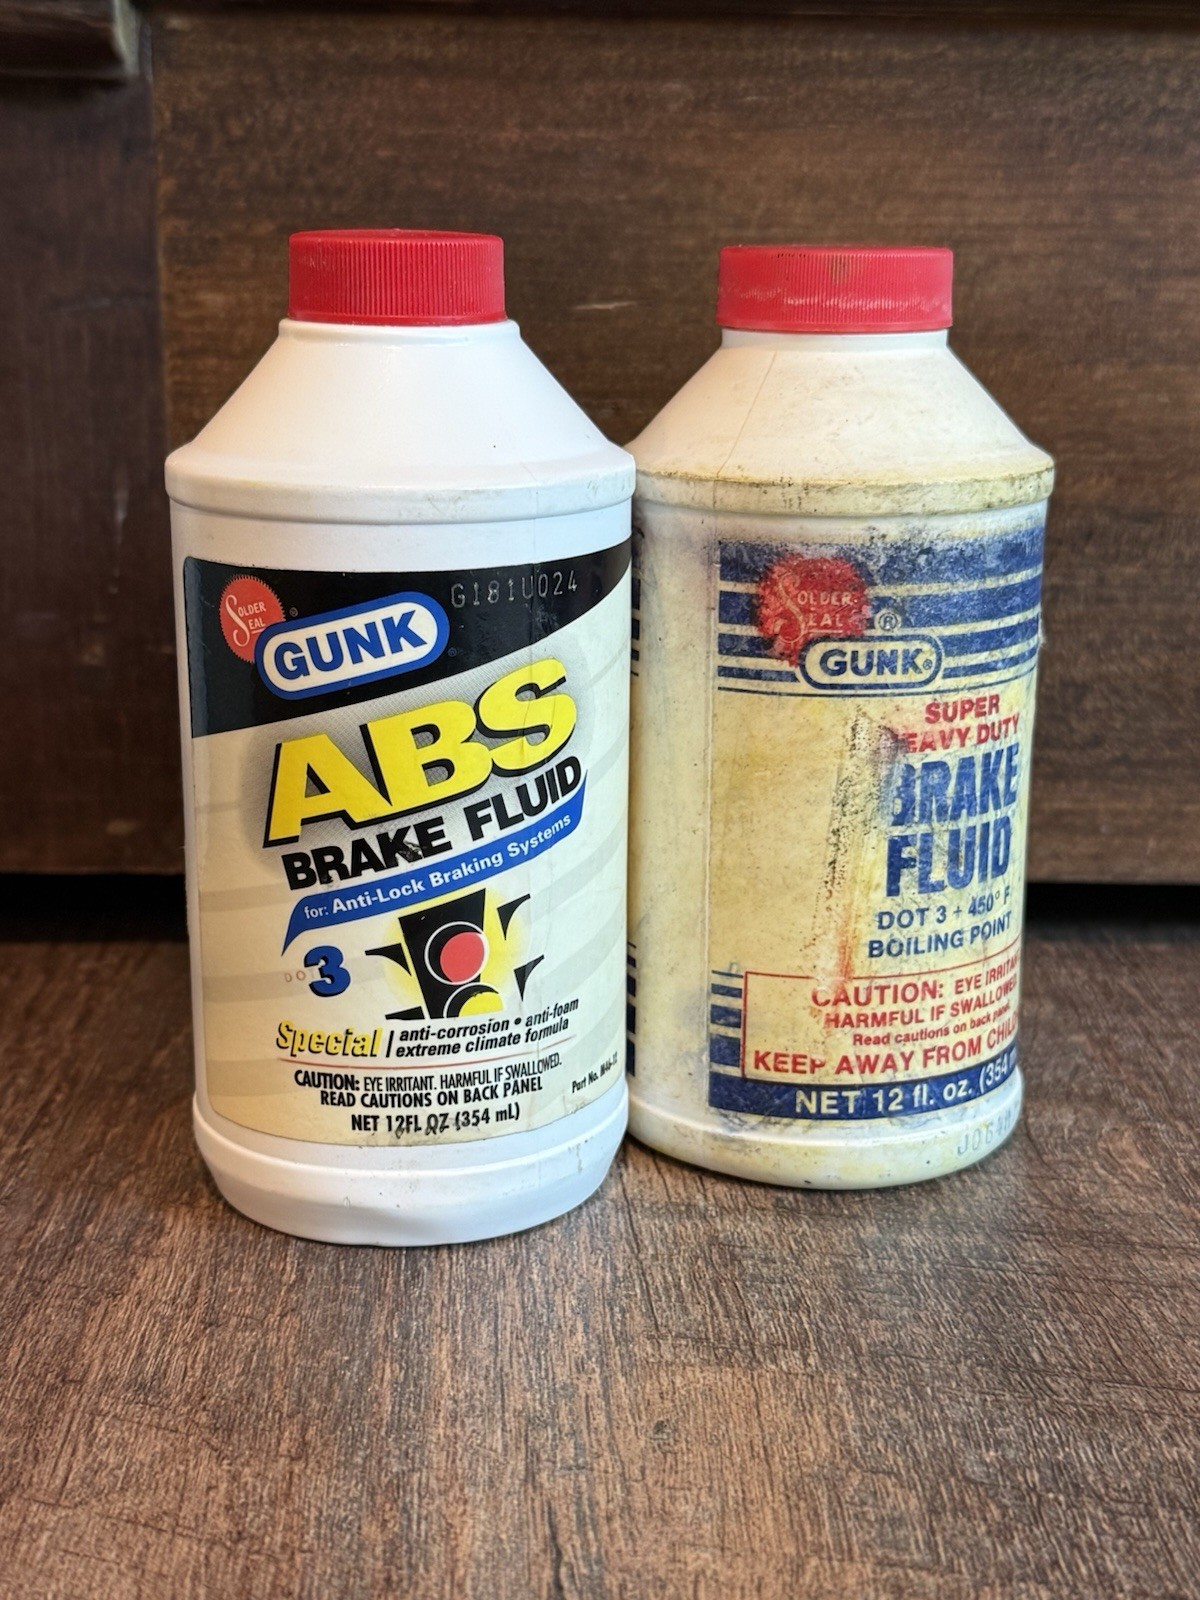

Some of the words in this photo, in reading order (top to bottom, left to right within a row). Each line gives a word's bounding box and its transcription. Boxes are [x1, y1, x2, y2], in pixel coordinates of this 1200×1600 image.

[274, 609, 428, 681] GUNK
[819, 648, 924, 677] GUNK
[925, 693, 1000, 724] SUPER
[263, 658, 578, 847] ABS
[901, 727, 970, 754] EAVY
[977, 712, 1020, 745] DUTY
[889, 742, 1019, 827] BRAKE
[281, 816, 453, 891] BRAKE
[463, 755, 582, 841] FLUID
[303, 905, 329, 919] for:
[332, 879, 426, 914] Anti-Lock
[428, 851, 504, 887] Braking
[507, 814, 572, 857] Systems
[886, 816, 1012, 897] FLUID
[877, 908, 929, 930] DOT
[936, 905, 947, 923] 3
[1003, 886, 1011, 905] F
[868, 930, 964, 958] BOILING
[970, 911, 1012, 943] POINT
[304, 945, 351, 997] 3
[811, 979, 943, 1007] CAUTION:
[955, 976, 981, 995] EYE
[399, 1018, 510, 1041] anti-corrosion
[525, 998, 579, 1027] anti-foam
[824, 1008, 923, 1030] HARMFUL
[931, 1005, 944, 1021] IF
[853, 1032, 890, 1047] Read
[895, 1026, 949, 1043] cautions
[953, 1022, 967, 1034] on
[970, 1014, 991, 1029] back
[276, 1019, 383, 1057] Special
[396, 1043, 461, 1057] extreme
[465, 1034, 521, 1053] climate
[525, 1018, 569, 1043] formula
[754, 1050, 825, 1074] KEEP
[835, 1052, 914, 1075] AWAY
[922, 1039, 981, 1069] FROM
[294, 1069, 360, 1091] CAUTION:
[364, 1076, 383, 1091] EYE
[385, 1075, 437, 1092] IRRITANT.
[440, 1071, 491, 1090] HARMFUL
[494, 1067, 504, 1082] IF
[505, 1052, 562, 1080] SWALLOWED.
[572, 1076, 586, 1094] Part
[320, 1090, 356, 1107] READ
[361, 1092, 432, 1108] CAUTIONS
[437, 1090, 458, 1106] ON
[464, 1085, 499, 1103] BACK
[504, 1076, 543, 1098] PANEL
[796, 1090, 861, 1114] NET
[873, 1088, 903, 1112] 12
[912, 1084, 934, 1106] fl.
[942, 1079, 972, 1101] oz.
[351, 1114, 379, 1131] NET
[455, 1108, 490, 1131] (354
[496, 1102, 520, 1123] mL)
